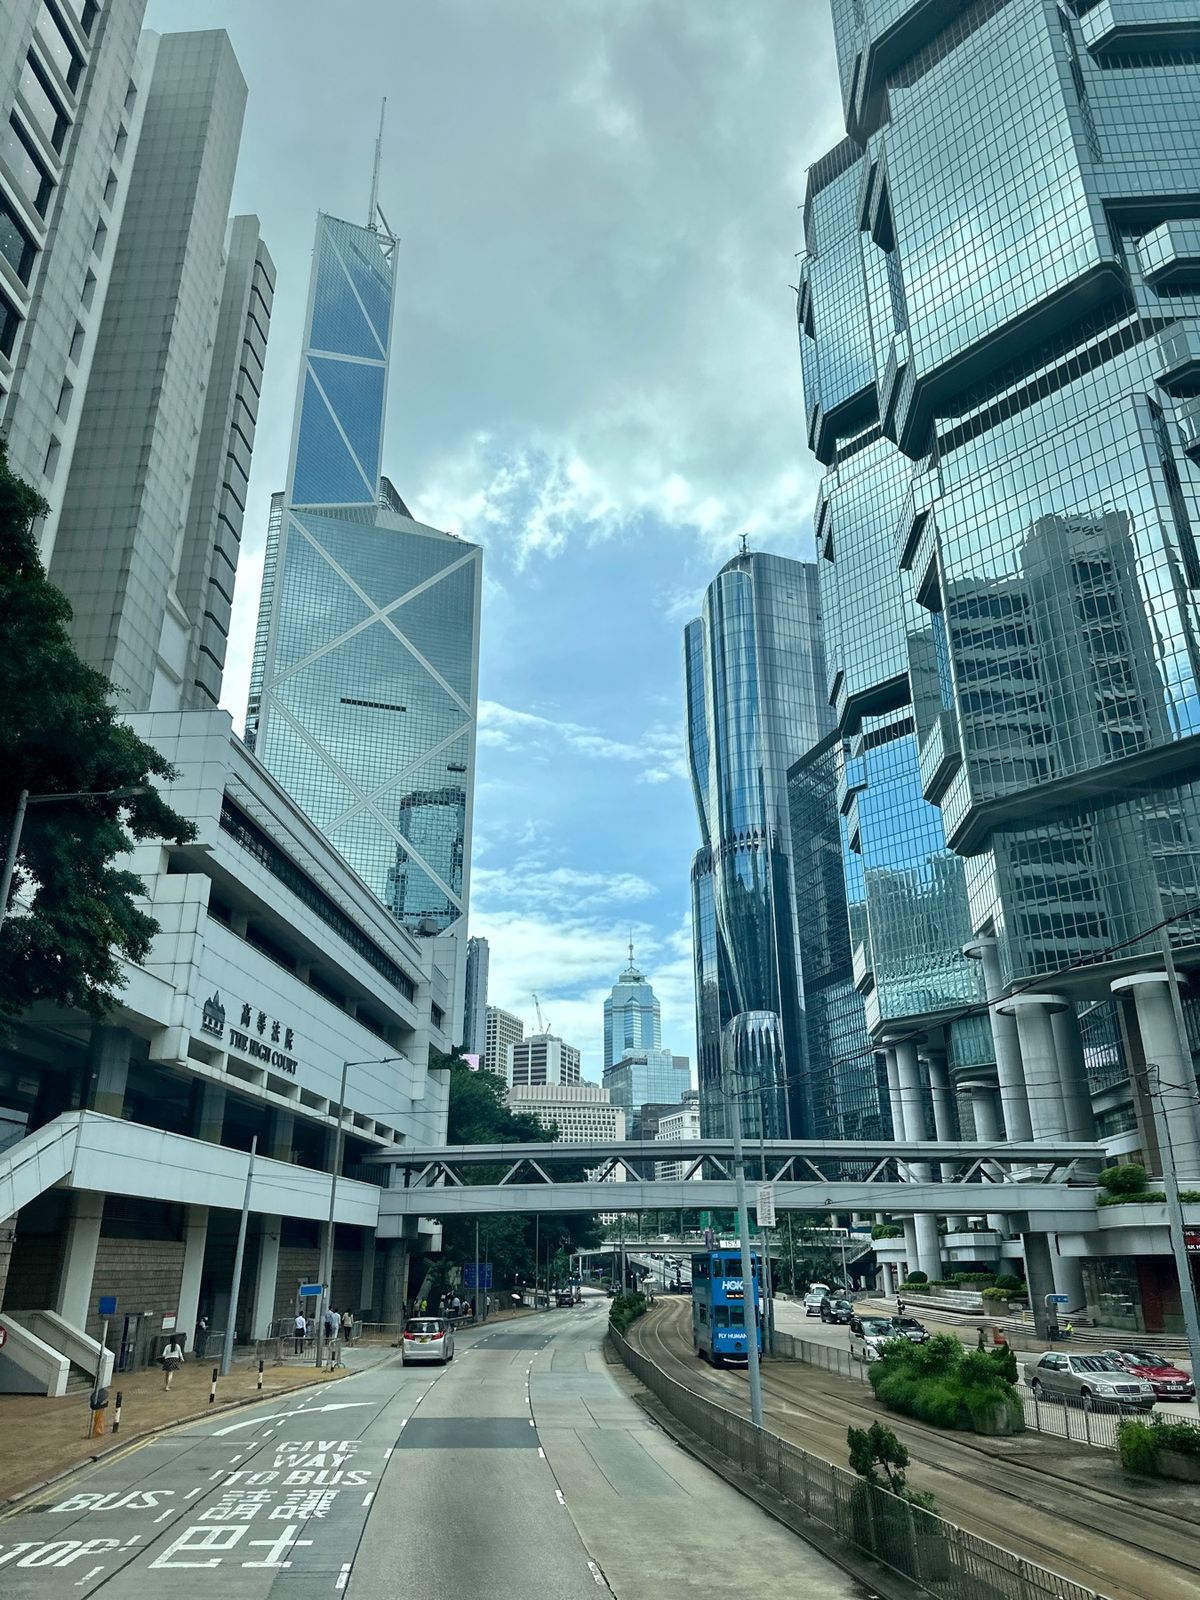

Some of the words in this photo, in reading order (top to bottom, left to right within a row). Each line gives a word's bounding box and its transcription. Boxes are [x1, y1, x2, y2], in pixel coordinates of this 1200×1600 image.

[240, 1003, 295, 1051] 高等法院
[229, 1028, 249, 1052] THE
[248, 1038, 272, 1064] HIGH
[271, 1050, 298, 1076] COURT
[722, 1281, 744, 1291] HOK
[275, 1440, 363, 1453] GIVE
[272, 1454, 354, 1468] WAY
[221, 1470, 280, 1487] TO
[281, 1470, 372, 1486] BUS
[48, 1490, 175, 1513] BUS
[197, 1489, 341, 1520] 請讓
[0, 1538, 120, 1568] TOP
[147, 1525, 314, 1569] 巴士
